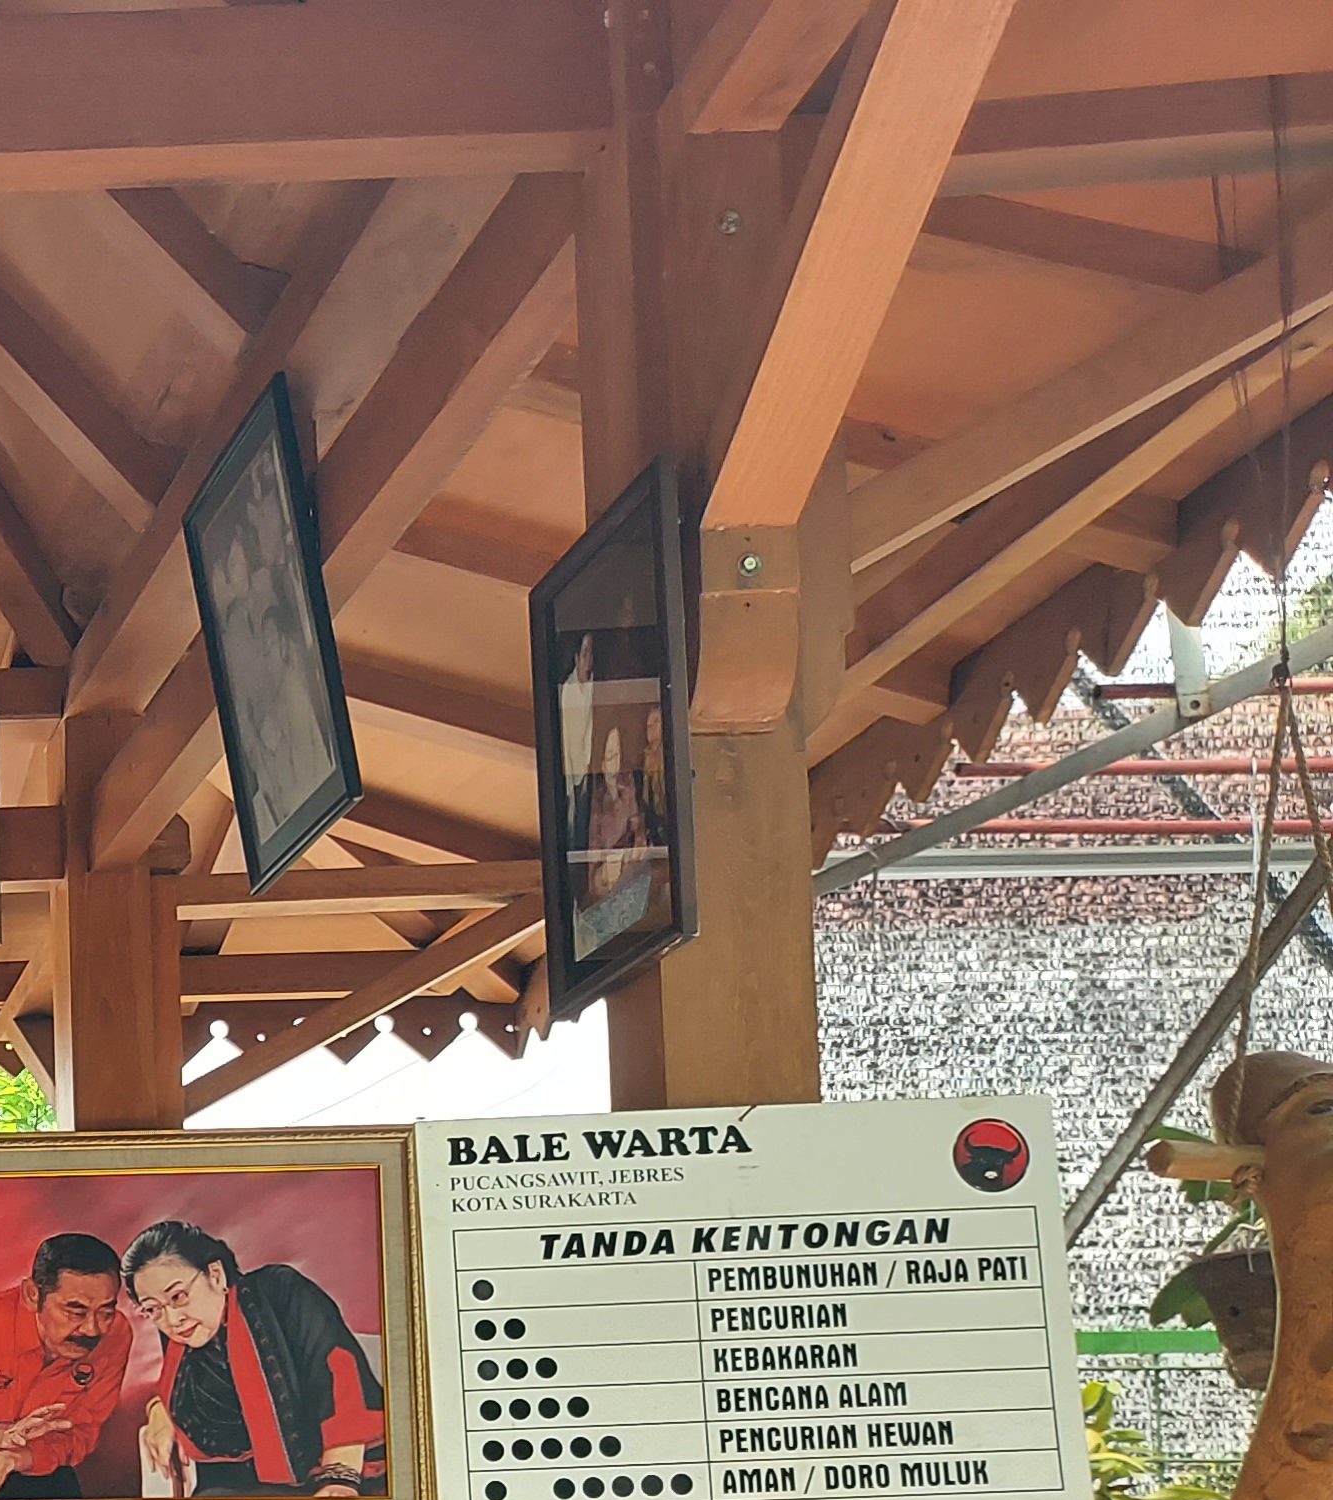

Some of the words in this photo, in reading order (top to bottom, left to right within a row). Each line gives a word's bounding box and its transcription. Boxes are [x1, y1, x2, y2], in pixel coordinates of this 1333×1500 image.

[447, 1132, 571, 1167] BALE
[582, 1125, 753, 1160] WARTA
[449, 1169, 604, 1192] PUCANGSAWIT,
[608, 1166, 685, 1184] JEBRES
[451, 1195, 508, 1213] KOTA
[511, 1190, 638, 1210] SURAKARTA
[539, 1230, 677, 1260] TANDA
[691, 1217, 952, 1254] KENTONGAN
[707, 1262, 878, 1293] PEMBUNUHAN
[905, 1257, 970, 1284] RAJA
[978, 1253, 1030, 1281] PATI
[710, 1302, 849, 1333] PENCURIAN
[713, 1343, 859, 1373] KEBAKARAN
[716, 1385, 831, 1413] BENCANA
[838, 1381, 909, 1408] ALAM
[719, 1424, 859, 1454] PENCURIAN
[867, 1420, 955, 1448] HEWAN
[722, 1466, 796, 1494] AMAN
[824, 1463, 892, 1489] DORO
[899, 1459, 990, 1485] MULUK
